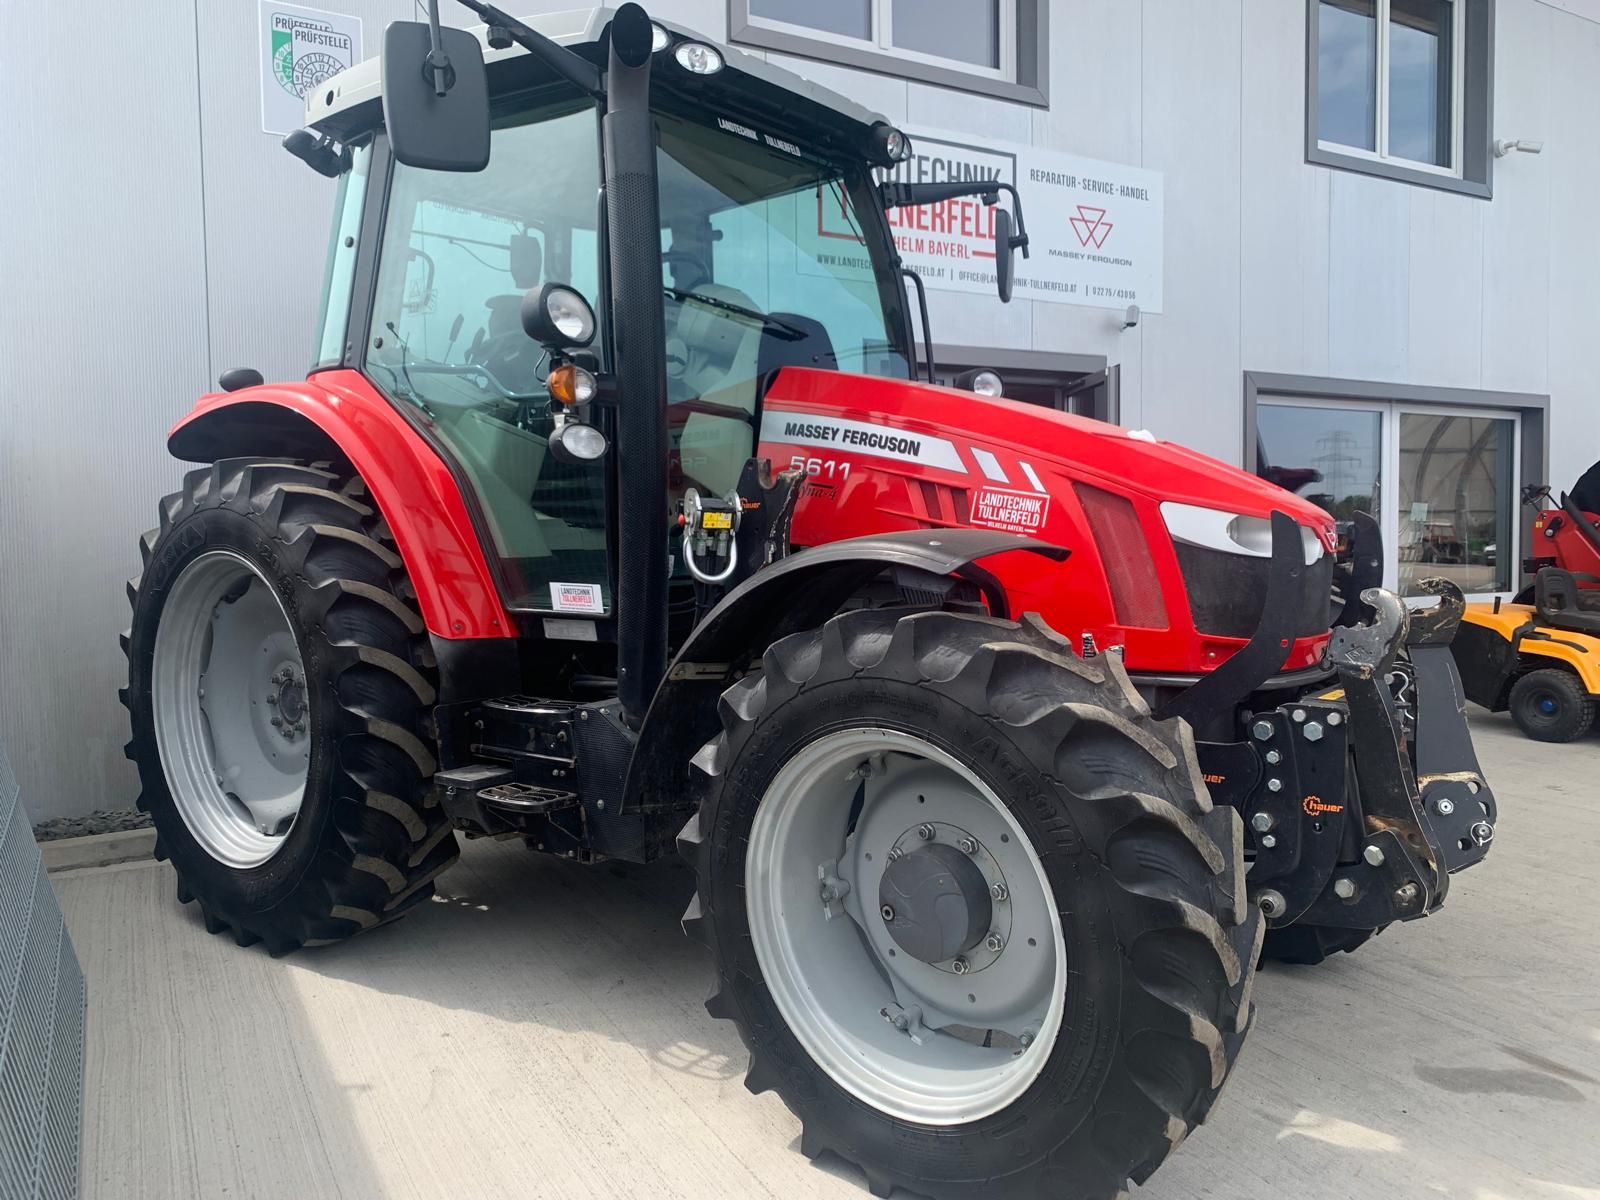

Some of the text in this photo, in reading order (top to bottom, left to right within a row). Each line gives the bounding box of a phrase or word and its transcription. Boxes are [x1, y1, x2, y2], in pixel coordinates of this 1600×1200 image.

[295, 30, 349, 50] PRÜFSTELLE
[1030, 168, 1077, 188] REPARATUR
[1082, 178, 1114, 195] SERVICE
[1120, 185, 1149, 201] HANDEL
[928, 240, 971, 260] BAYERL
[1048, 249, 1133, 267] MASSEY FERGUSON
[784, 422, 921, 457] MASSEY FERGUSON
[788, 455, 851, 480] 5611
[979, 491, 1042, 513] LANDTECHNIK
[978, 505, 1040, 527] TULLNERFELD
[1308, 800, 1343, 814] hauer
